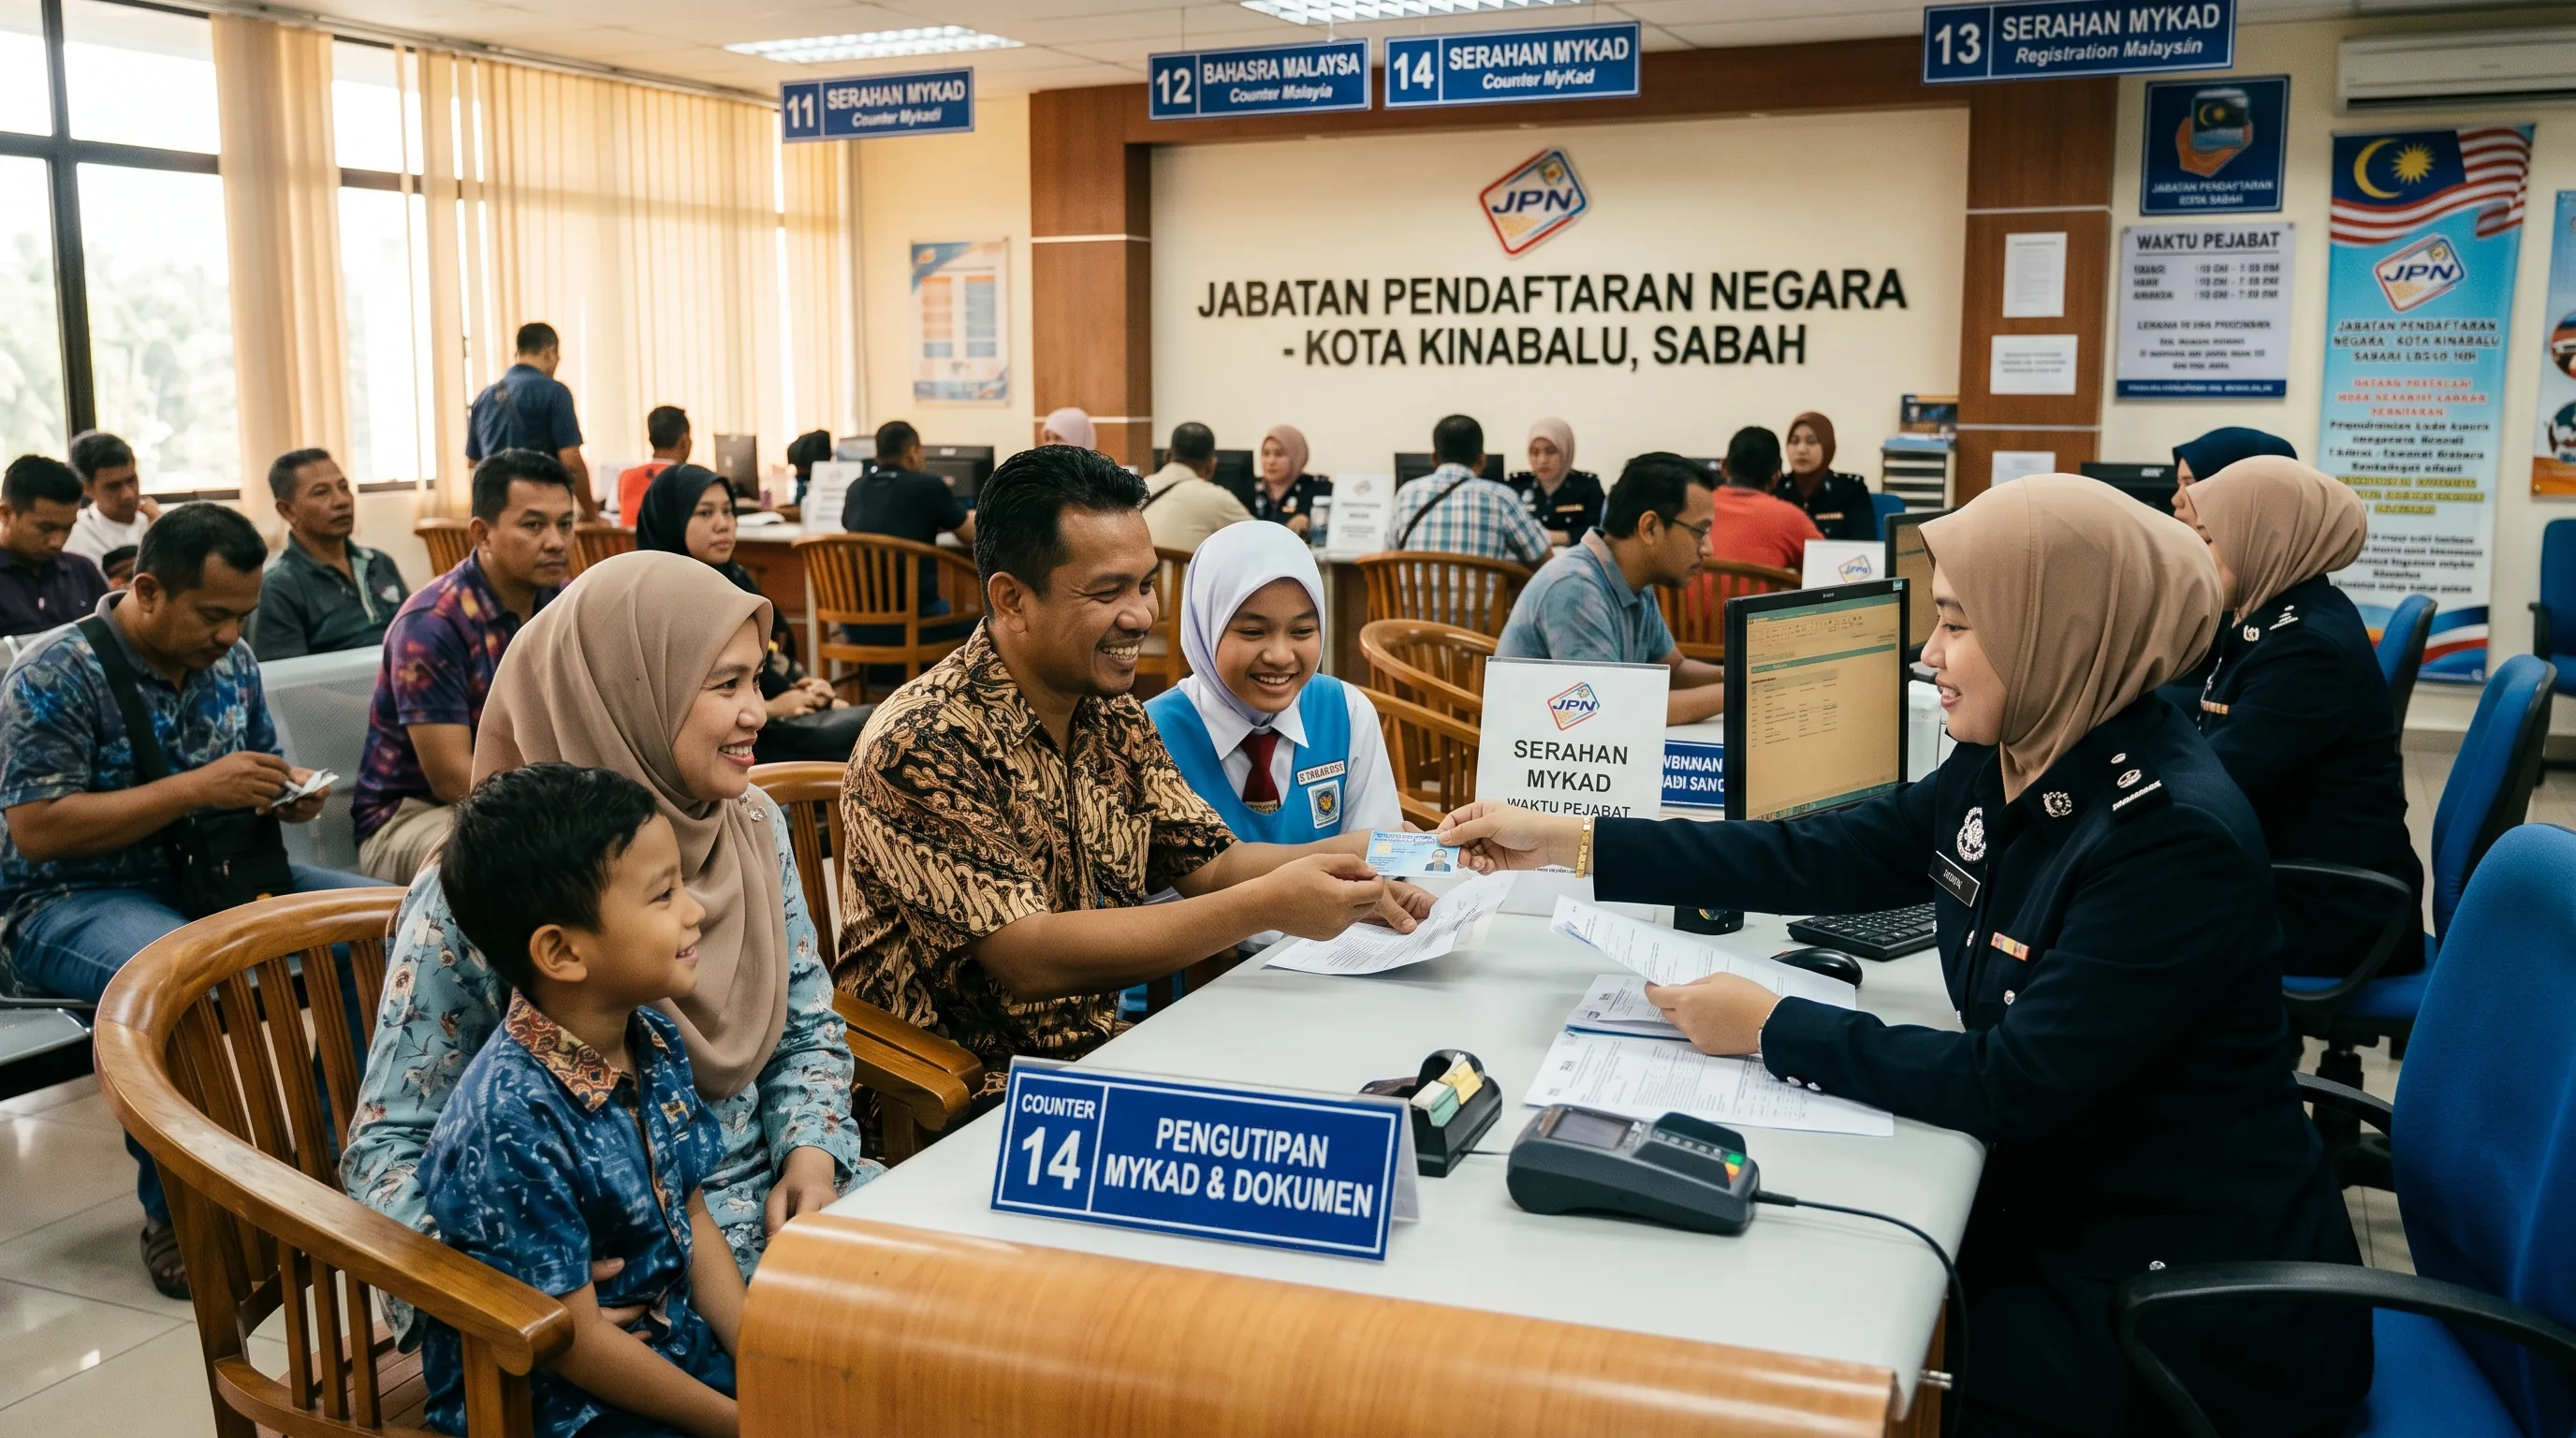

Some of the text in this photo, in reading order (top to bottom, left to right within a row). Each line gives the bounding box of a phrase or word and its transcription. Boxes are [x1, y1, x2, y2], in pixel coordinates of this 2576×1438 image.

[2002, 4, 2220, 41] SERAHAN MYKAD
[1449, 37, 1629, 70] SERAHAN MYKAD
[1935, 23, 1981, 66] 13
[2015, 44, 2118, 66] Registration
[1203, 52, 1361, 84] BAHASRA MALAYSA
[1393, 51, 1434, 90] 14
[1482, 68, 1595, 90] Counter MyKad
[827, 80, 966, 110] SERAHAN MYKAD
[1156, 67, 1192, 104] 12
[1230, 86, 1280, 103] Counter
[786, 95, 815, 128] 11
[852, 111, 898, 127] Counter
[1492, 187, 1573, 213] JPN
[2137, 231, 2280, 250] WAKTU PEJABAT
[2383, 264, 2454, 282] JPN
[1198, 268, 1909, 318] JABATAN PENDAFTARAN NEGARA
[1306, 329, 1407, 365] KOTA
[1420, 325, 1639, 373] KINABALU,
[1653, 324, 1807, 365] SABAH
[1552, 699, 1596, 712] JPN
[1514, 739, 1628, 765] SERAHAN
[1527, 769, 1612, 793] MYKAD
[1507, 798, 1559, 814] WAKTU
[1563, 801, 1631, 818] PEJABAT
[1021, 1093, 1095, 1120] COUNTER
[1155, 1117, 1329, 1168] PENGUTIPAN
[1021, 1125, 1081, 1190] 14
[1104, 1153, 1373, 1218] MYKAD & DOKUMEN
